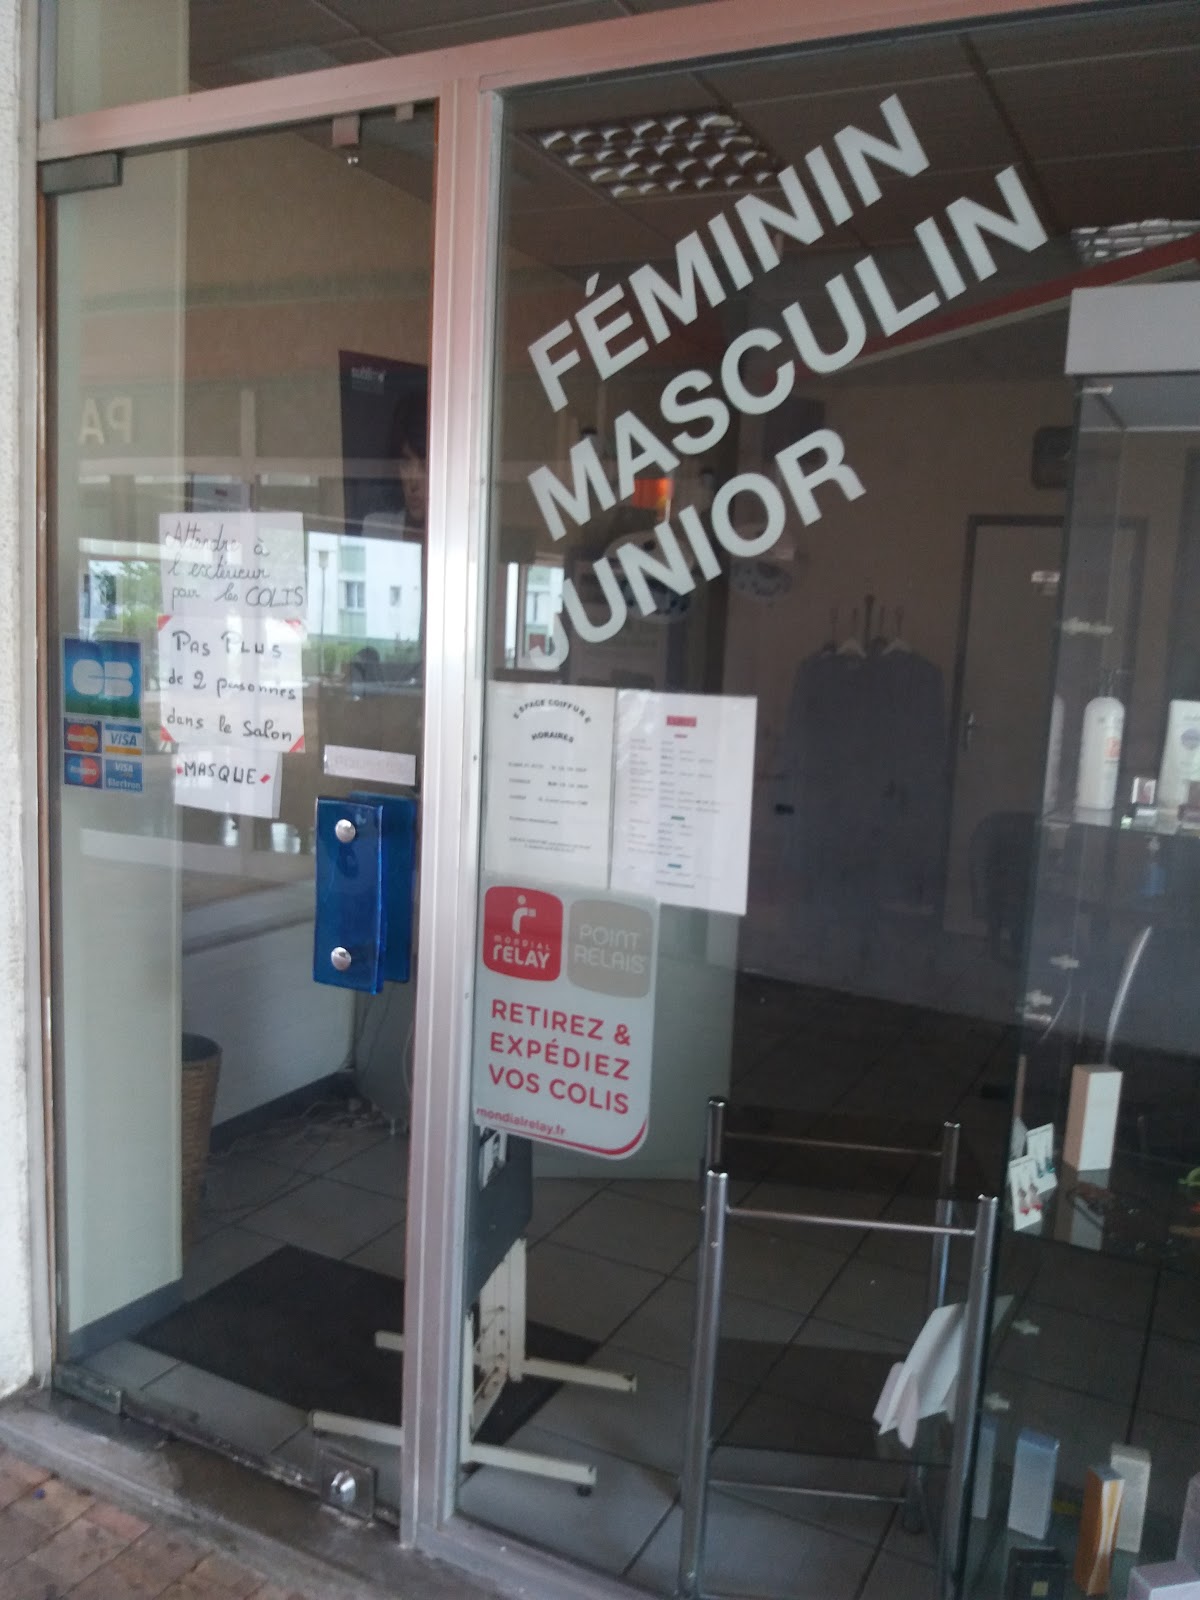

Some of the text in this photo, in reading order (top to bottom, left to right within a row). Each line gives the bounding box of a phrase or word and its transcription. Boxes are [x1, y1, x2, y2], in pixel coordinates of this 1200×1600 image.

[527, 94, 930, 412] FÉMININ
[527, 165, 1048, 541] MASCULIN
[253, 537, 270, 556] à
[529, 429, 866, 671] JUNIOR
[245, 585, 304, 608] COLIS
[172, 630, 211, 657] PAS
[168, 668, 184, 686] de
[193, 669, 207, 690] 2
[167, 707, 293, 742] dans le Salon
[512, 698, 592, 724] ESPACE COIFFURE
[110, 732, 137, 747] VISA
[530, 730, 575, 744] HORAIRES
[184, 761, 258, 785] MASQUE
[579, 923, 640, 951] POINT
[574, 943, 646, 975] RELAIS
[491, 998, 631, 1047] RETIREZ &
[490, 1031, 631, 1081] EXPÉDIEZ
[488, 1063, 630, 1115] VOS COLIS
[476, 1105, 567, 1136] mondialrelay.fr
